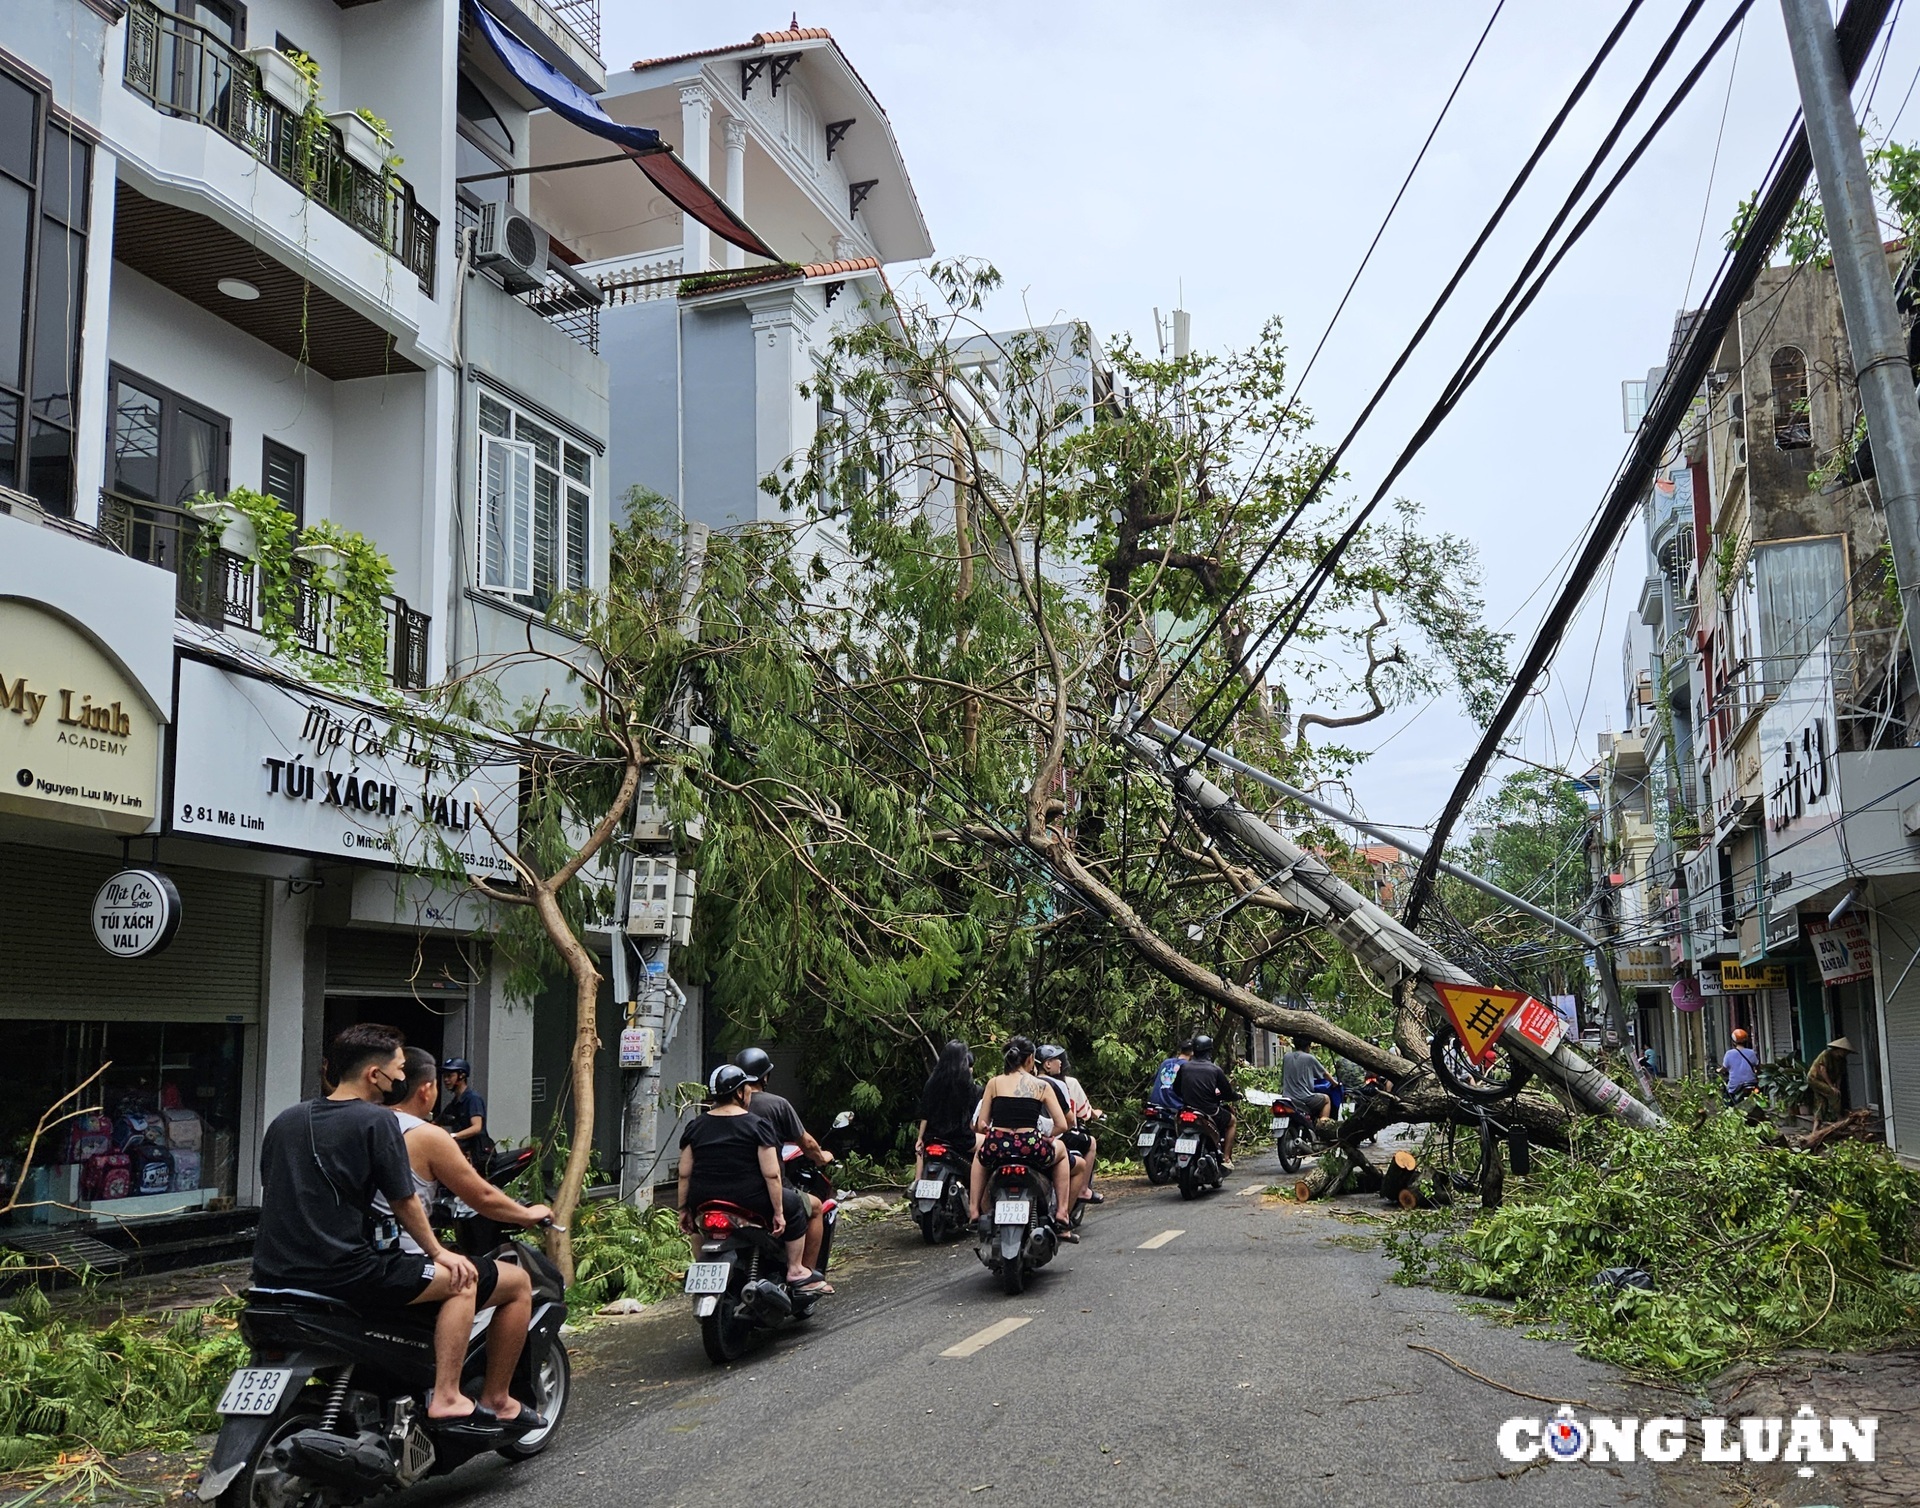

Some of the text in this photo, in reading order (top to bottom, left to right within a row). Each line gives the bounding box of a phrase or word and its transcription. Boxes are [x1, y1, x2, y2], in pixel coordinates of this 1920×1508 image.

[0, 673, 132, 738] My Linh
[57, 731, 128, 756] ACADEMY
[36, 778, 142, 808] Nguyen Luu My Linh
[264, 754, 315, 800] TÚI
[321, 766, 397, 817] XÁCH
[421, 794, 471, 831] VALI
[197, 806, 265, 831] 81 Mê Linh
[456, 851, 513, 872] 355.219.219
[106, 884, 128, 906] Mít
[132, 901, 153, 909] SHOP
[101, 911, 154, 929] TÚI XÁCH
[113, 934, 139, 948] VALI
[696, 1265, 722, 1277] 15-B1
[238, 1371, 281, 1390] 15-B3
[222, 1392, 276, 1411] 415.68
